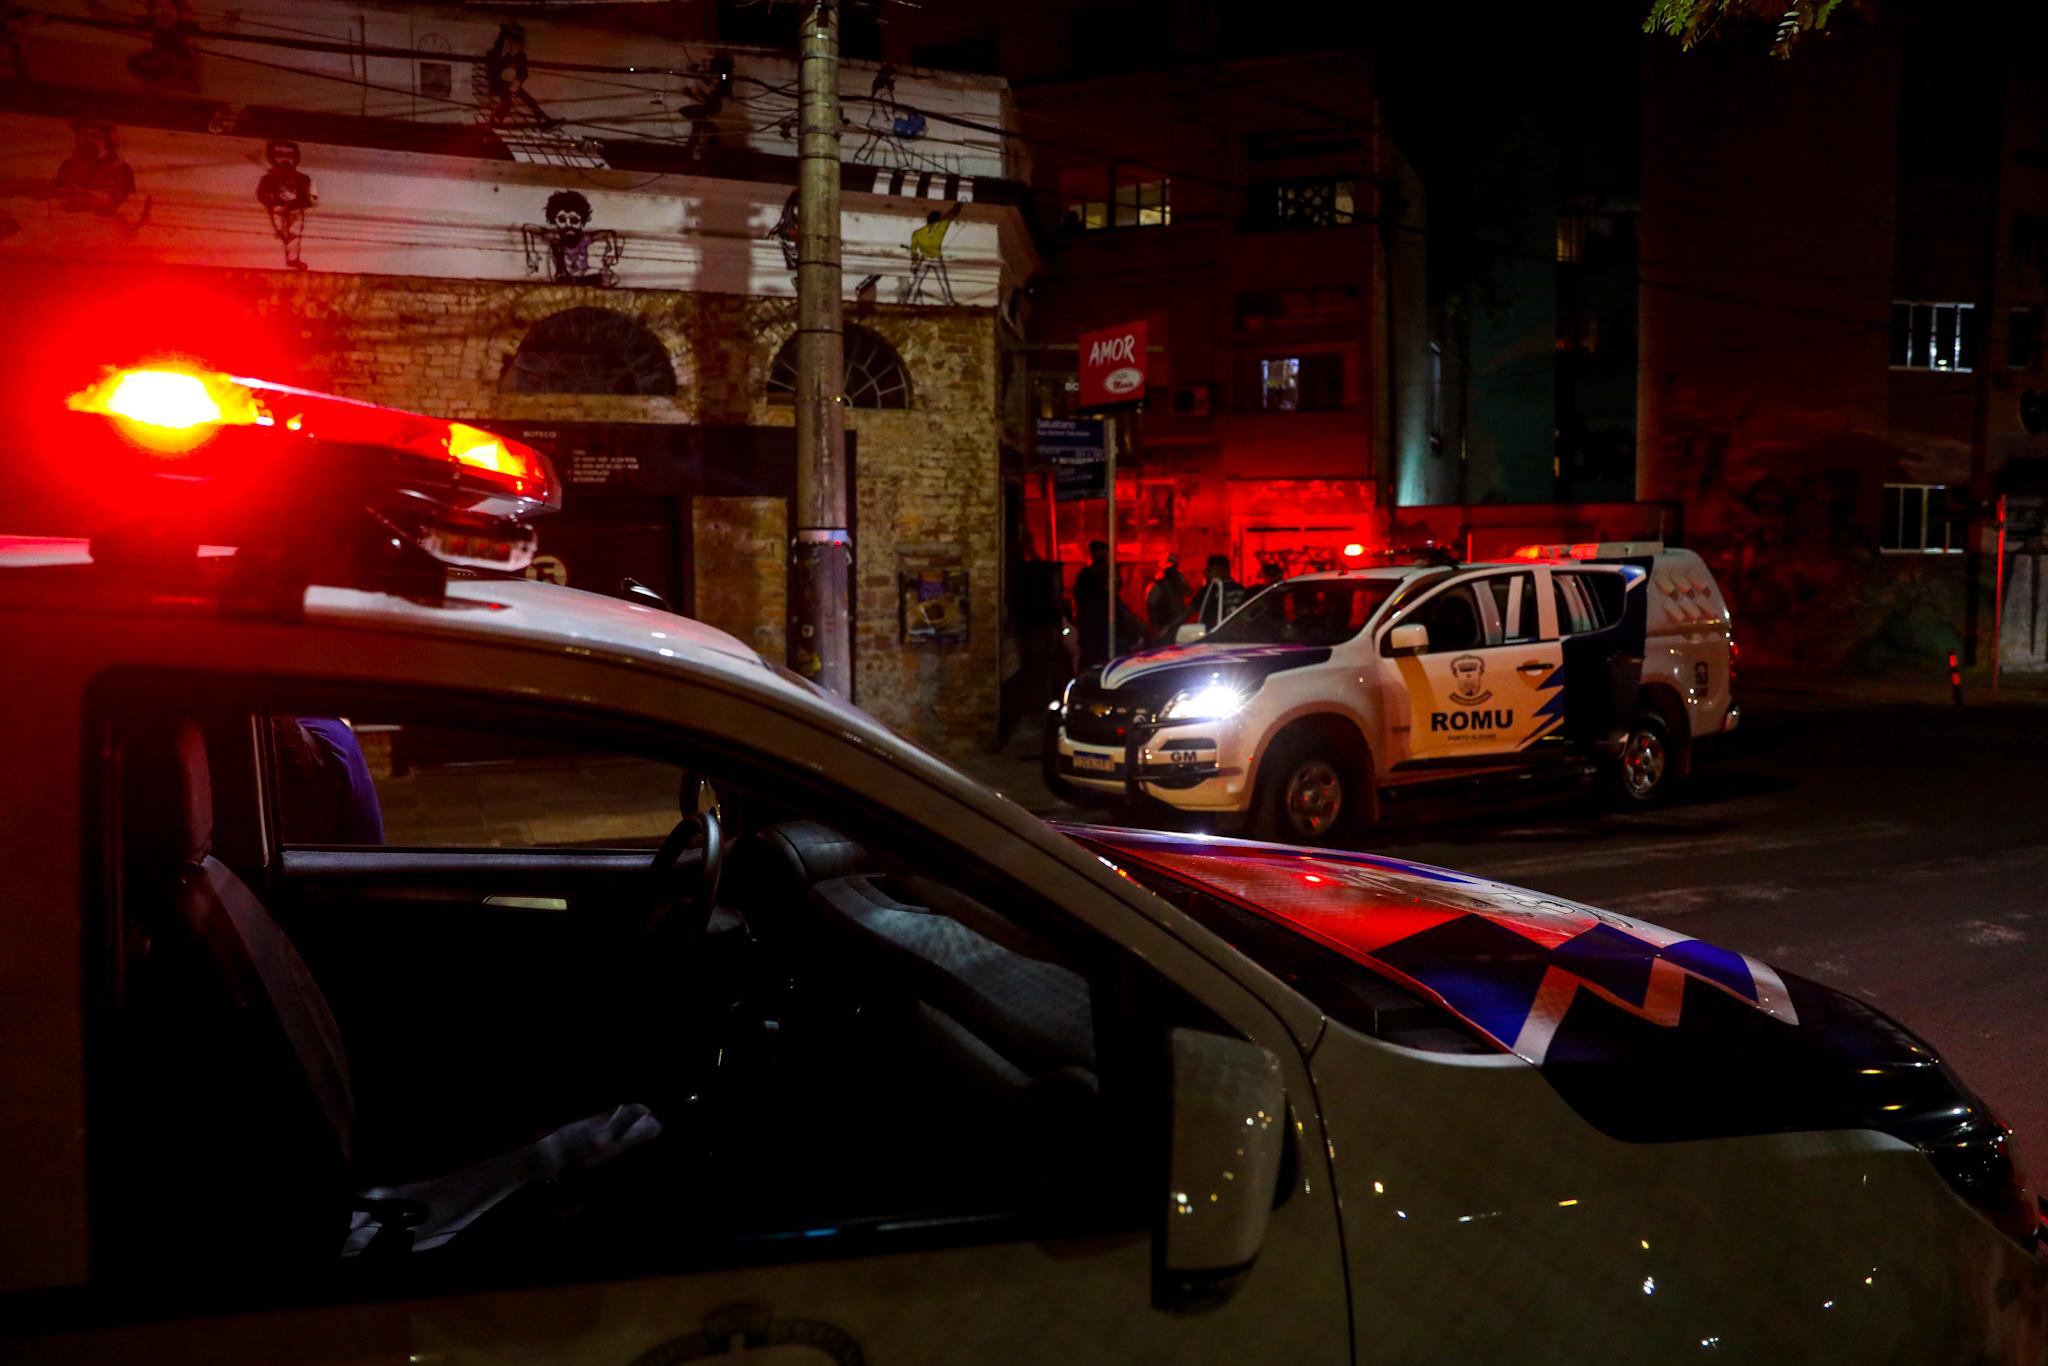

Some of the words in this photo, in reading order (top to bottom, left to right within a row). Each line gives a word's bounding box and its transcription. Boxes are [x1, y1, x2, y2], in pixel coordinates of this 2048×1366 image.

[1088, 334, 1136, 367] AMOR
[1431, 710, 1513, 731] ROMU
[1170, 751, 1198, 763] GM
